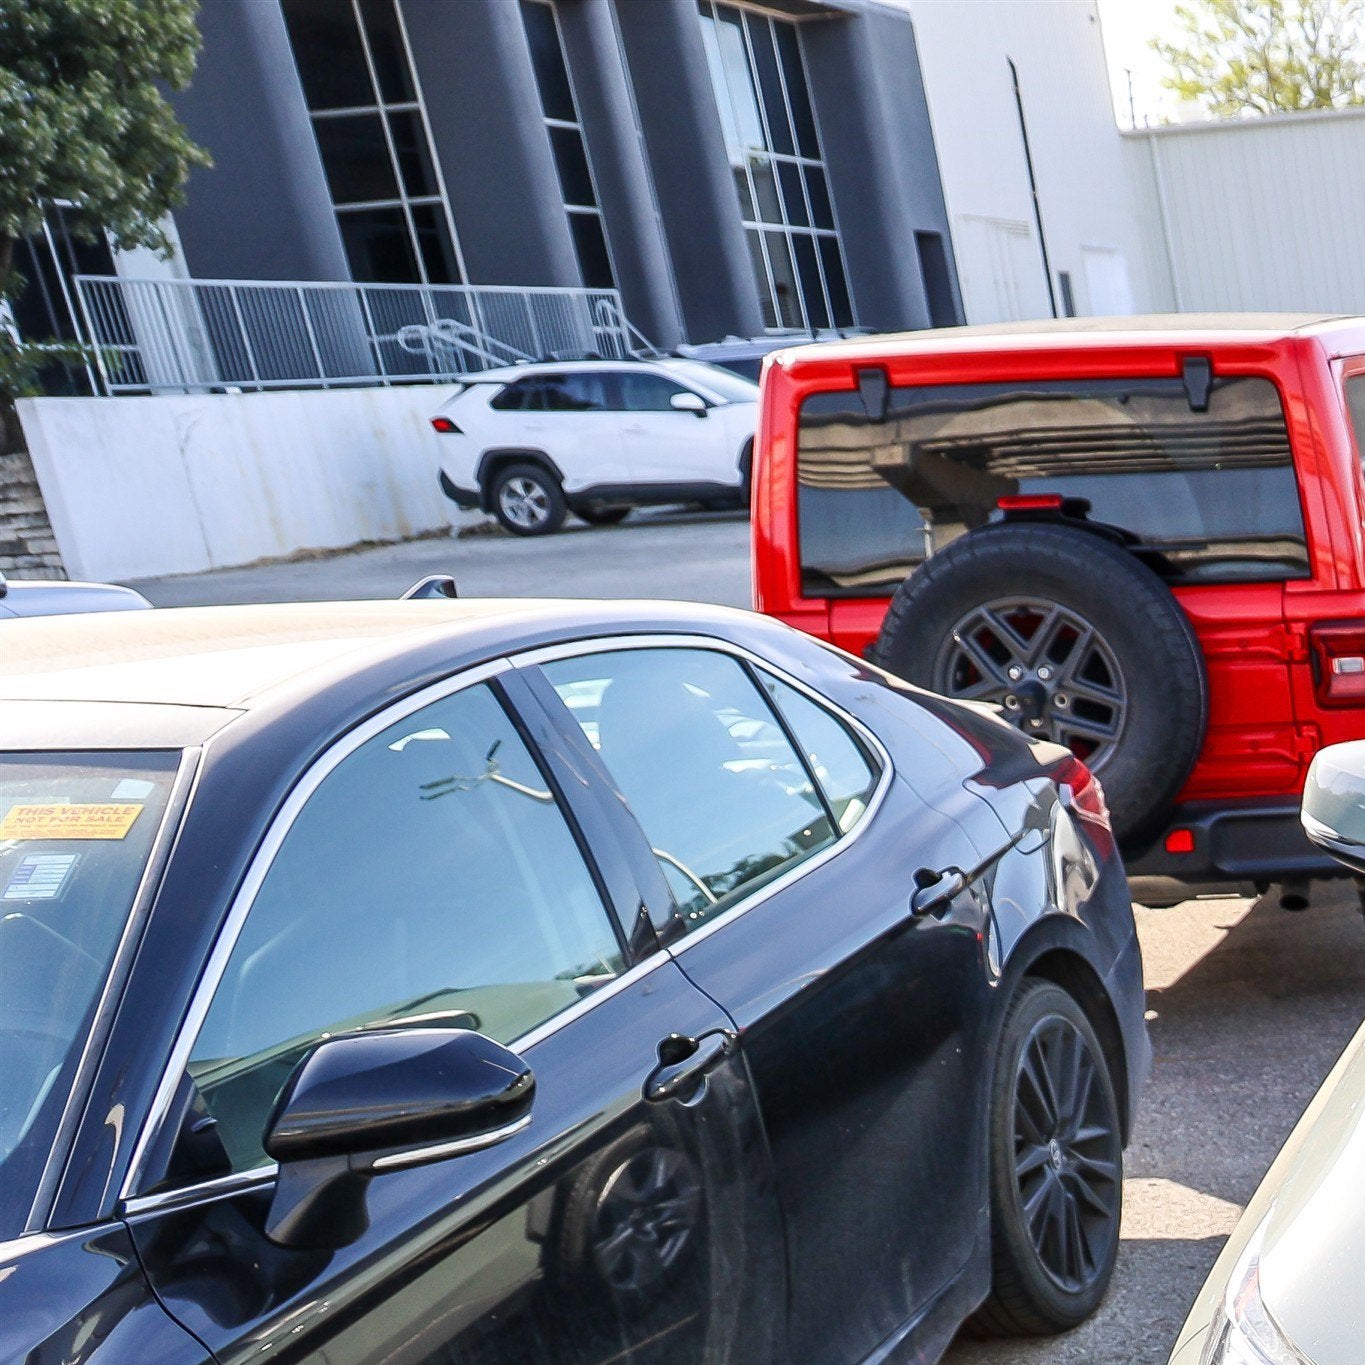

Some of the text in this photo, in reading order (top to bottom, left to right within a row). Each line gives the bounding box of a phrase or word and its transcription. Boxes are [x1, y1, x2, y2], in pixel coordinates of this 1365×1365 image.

[18, 807, 136, 815] THIS VEHICLE
[14, 816, 46, 824] NOT
